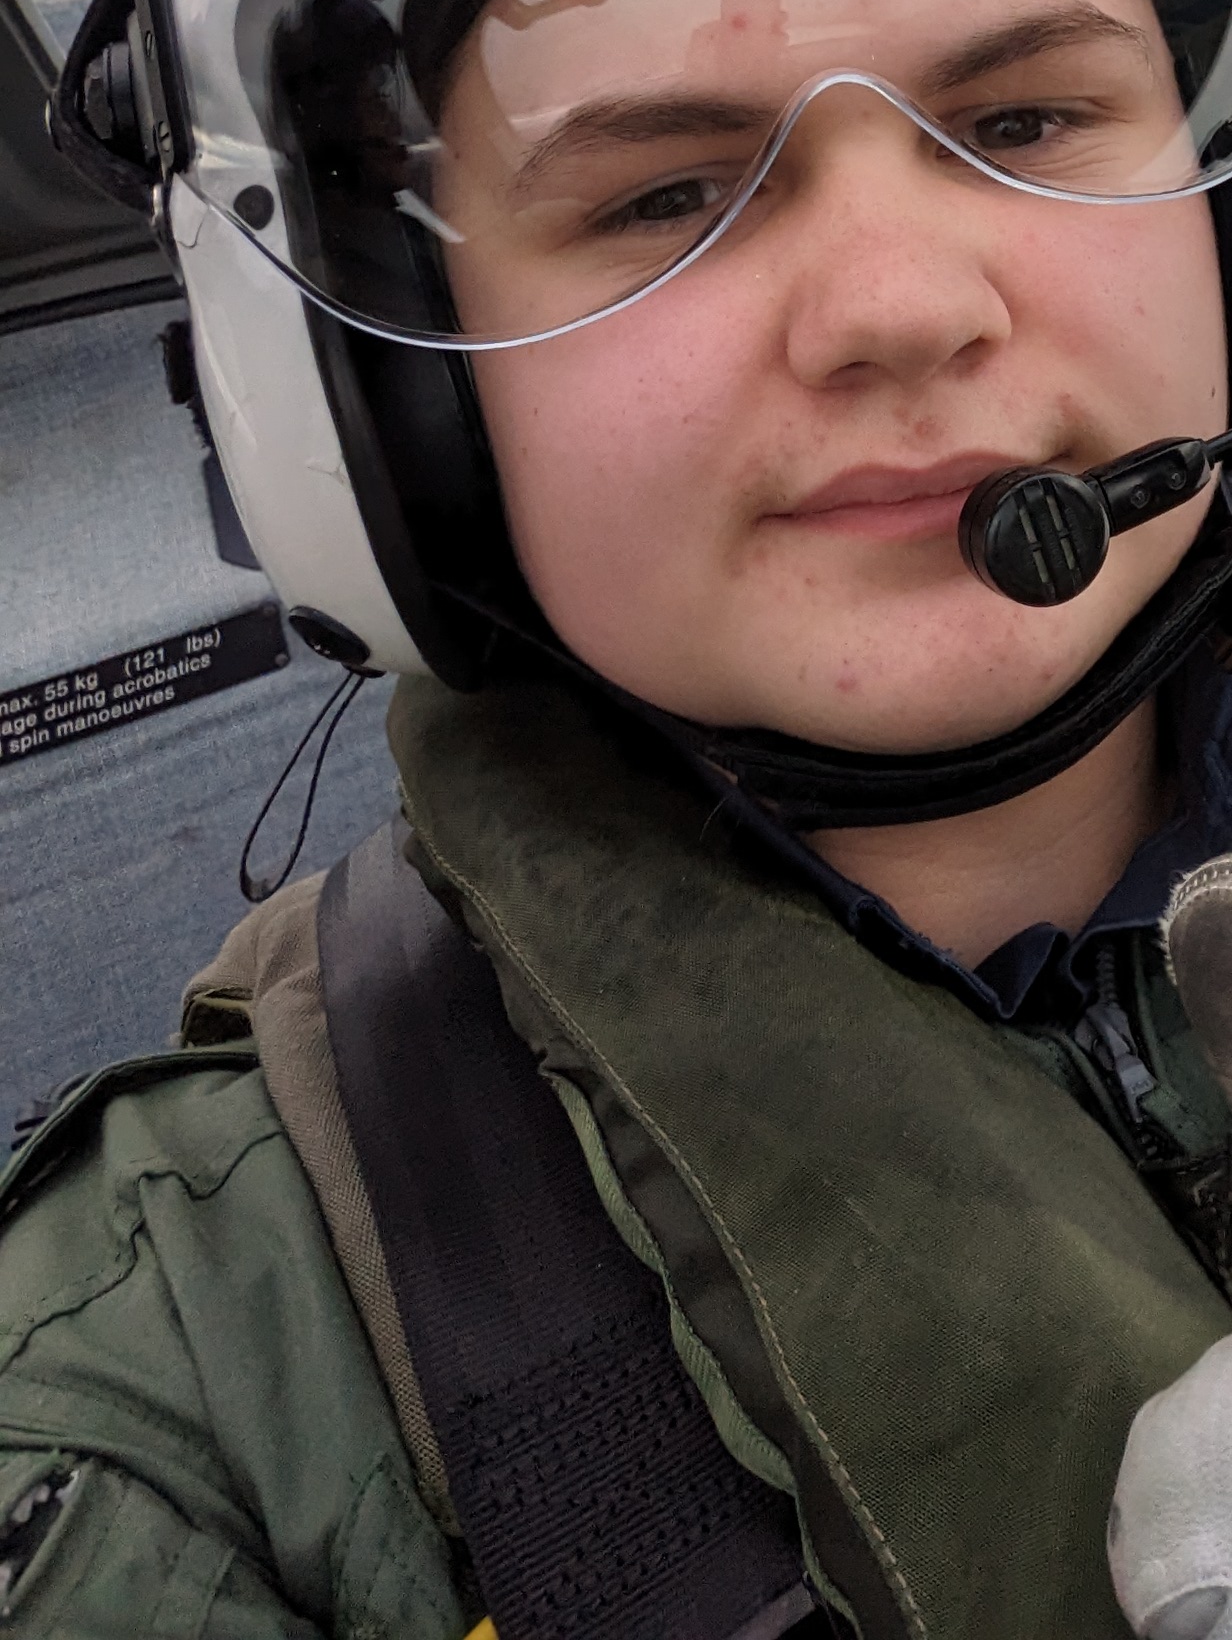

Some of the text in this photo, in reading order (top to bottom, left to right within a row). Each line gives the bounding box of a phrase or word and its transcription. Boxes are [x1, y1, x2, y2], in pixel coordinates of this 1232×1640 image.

[44, 682, 69, 702] 55
[75, 671, 98, 692] kg
[124, 647, 166, 677] (121
[186, 628, 221, 653] lbs)
[44, 689, 106, 722] during
[113, 653, 212, 699] acrobatics
[9, 729, 50, 753] spin
[56, 686, 176, 738] manoeuvres
